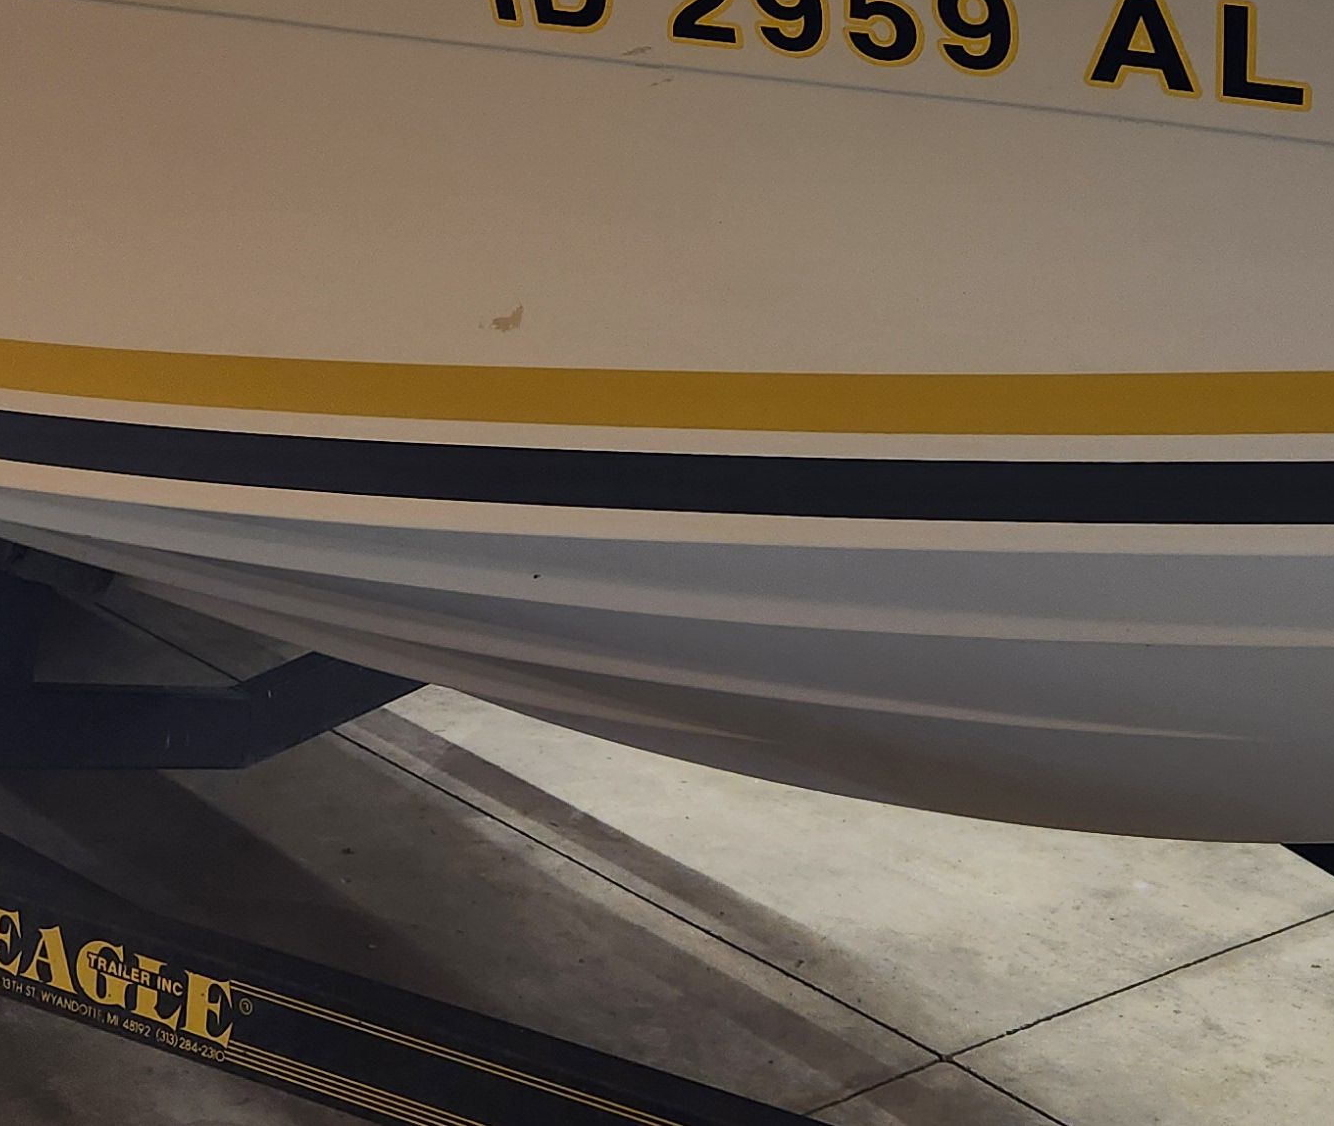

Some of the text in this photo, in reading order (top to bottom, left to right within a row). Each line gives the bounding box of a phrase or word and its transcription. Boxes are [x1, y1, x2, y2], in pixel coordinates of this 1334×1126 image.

[88, 953, 184, 996] TRAILER INC
[2, 977, 23, 993] 13TH
[107, 1012, 118, 1027] MI
[122, 1018, 151, 1037] 48192
